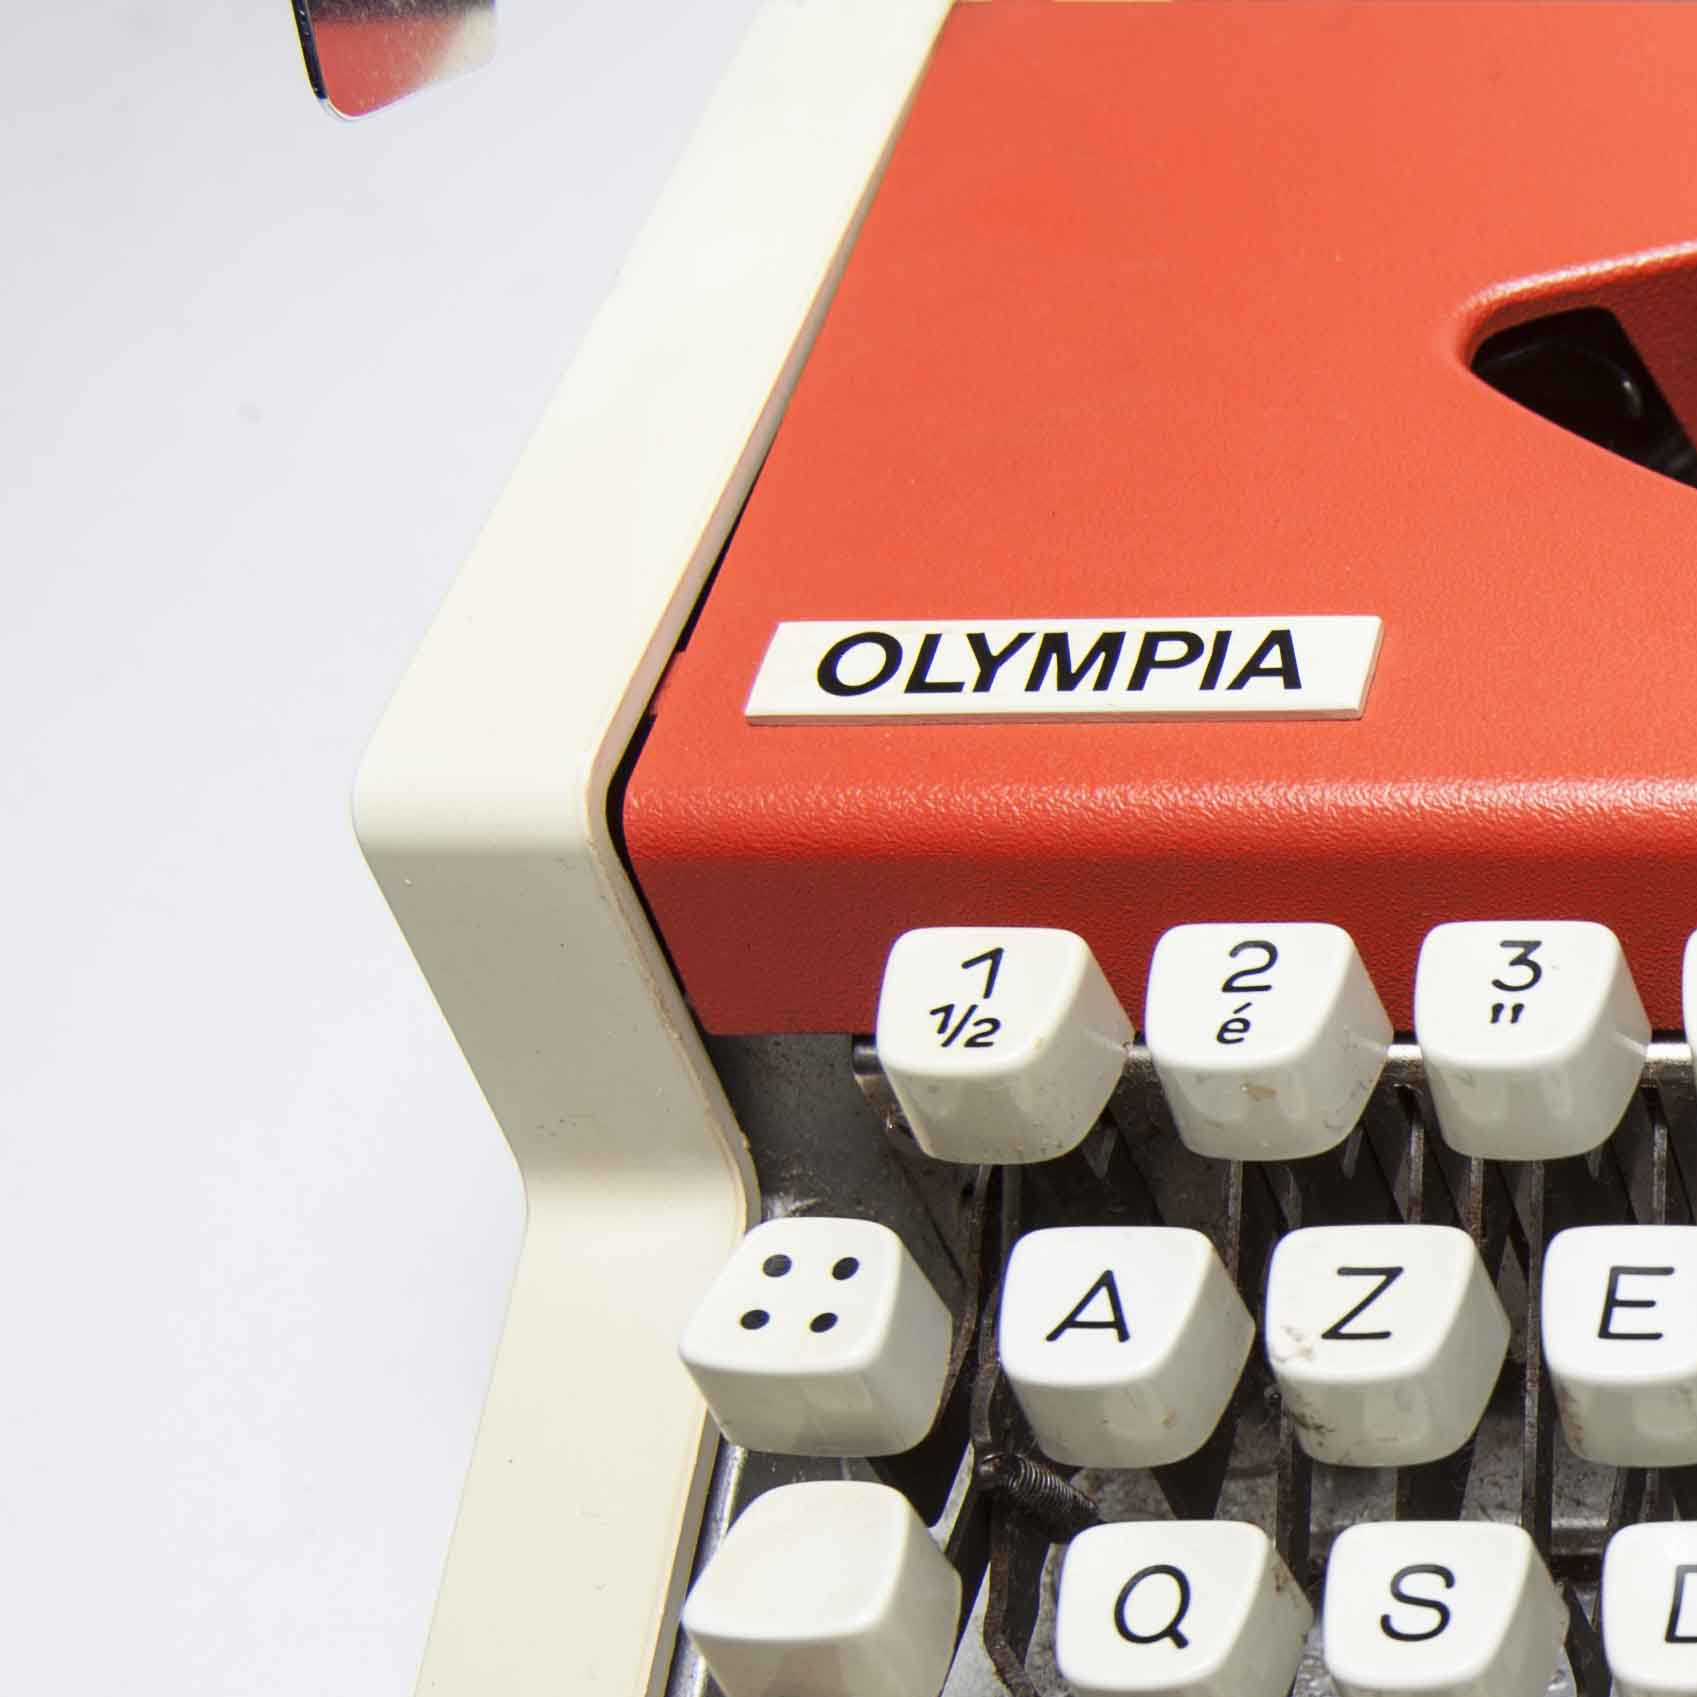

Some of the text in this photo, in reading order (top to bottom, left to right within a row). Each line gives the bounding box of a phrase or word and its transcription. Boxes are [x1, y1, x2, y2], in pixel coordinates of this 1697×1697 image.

[816, 628, 1303, 698] OLYMPIA
[960, 946, 1005, 1001] 1
[1220, 939, 1279, 994] 2
[1490, 939, 1543, 993] 3
[928, 1002, 1002, 1049] 1/2
[1215, 1001, 1253, 1046] é
[1044, 1268, 1131, 1344] A
[1320, 1265, 1405, 1342] Z
[1596, 1264, 1676, 1342] E
[1112, 1563, 1191, 1651] Q
[1379, 1563, 1456, 1644] S
